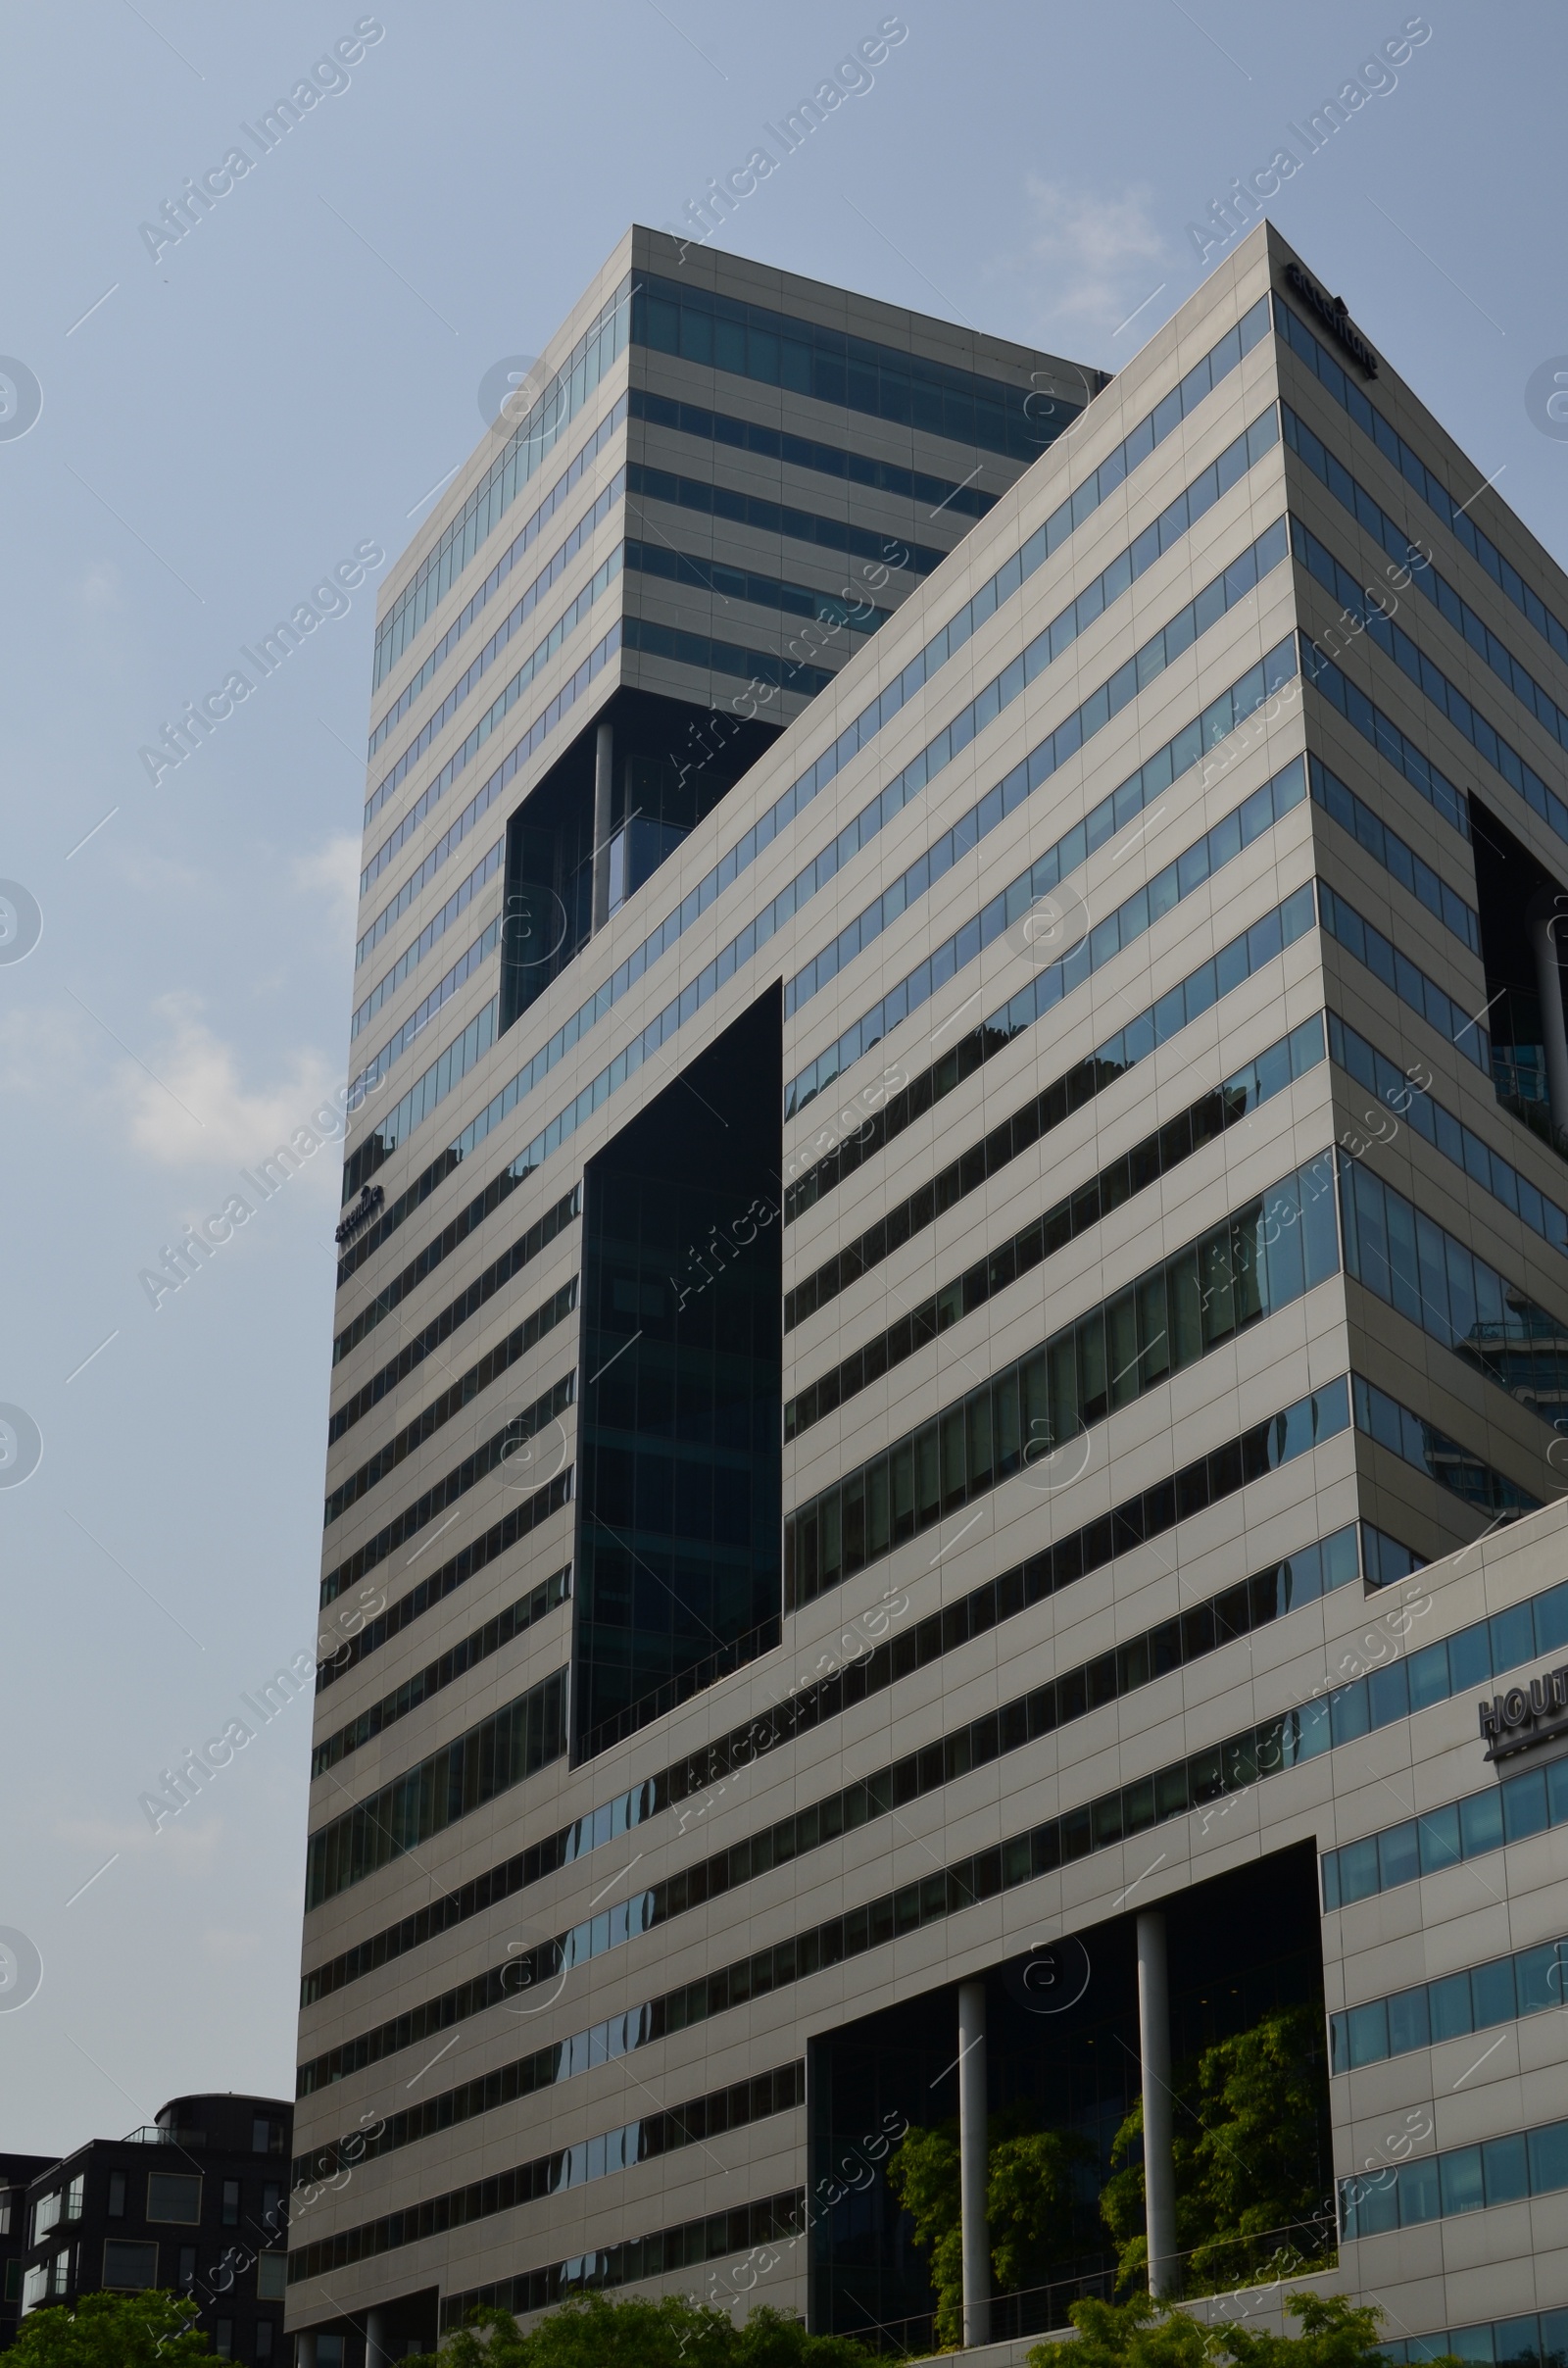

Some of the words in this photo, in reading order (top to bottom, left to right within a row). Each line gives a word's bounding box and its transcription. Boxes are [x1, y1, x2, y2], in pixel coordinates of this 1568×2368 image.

[1286, 262, 1379, 380] accenture
[334, 1184, 385, 1243] accenture
[1479, 1663, 1568, 1740] HOUT
